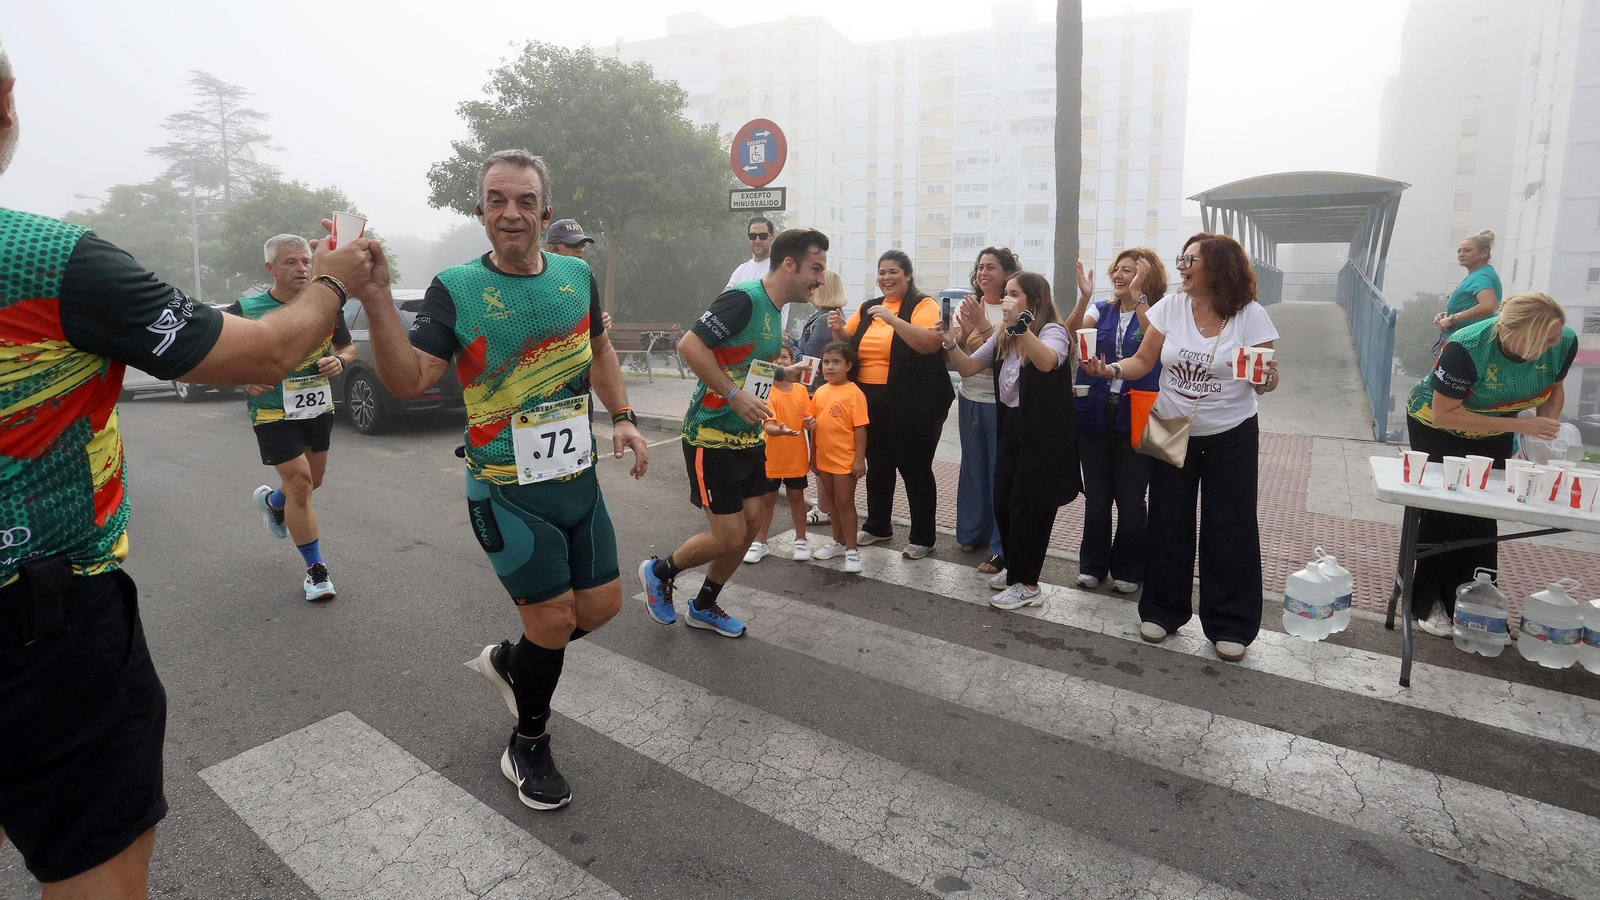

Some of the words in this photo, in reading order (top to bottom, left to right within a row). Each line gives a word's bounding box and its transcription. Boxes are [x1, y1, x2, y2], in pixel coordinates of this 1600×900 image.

[733, 199, 779, 208] MINUSVALIDO
[295, 391, 326, 409] 282
[540, 427, 576, 459] 72
[473, 506, 492, 547] WONG
